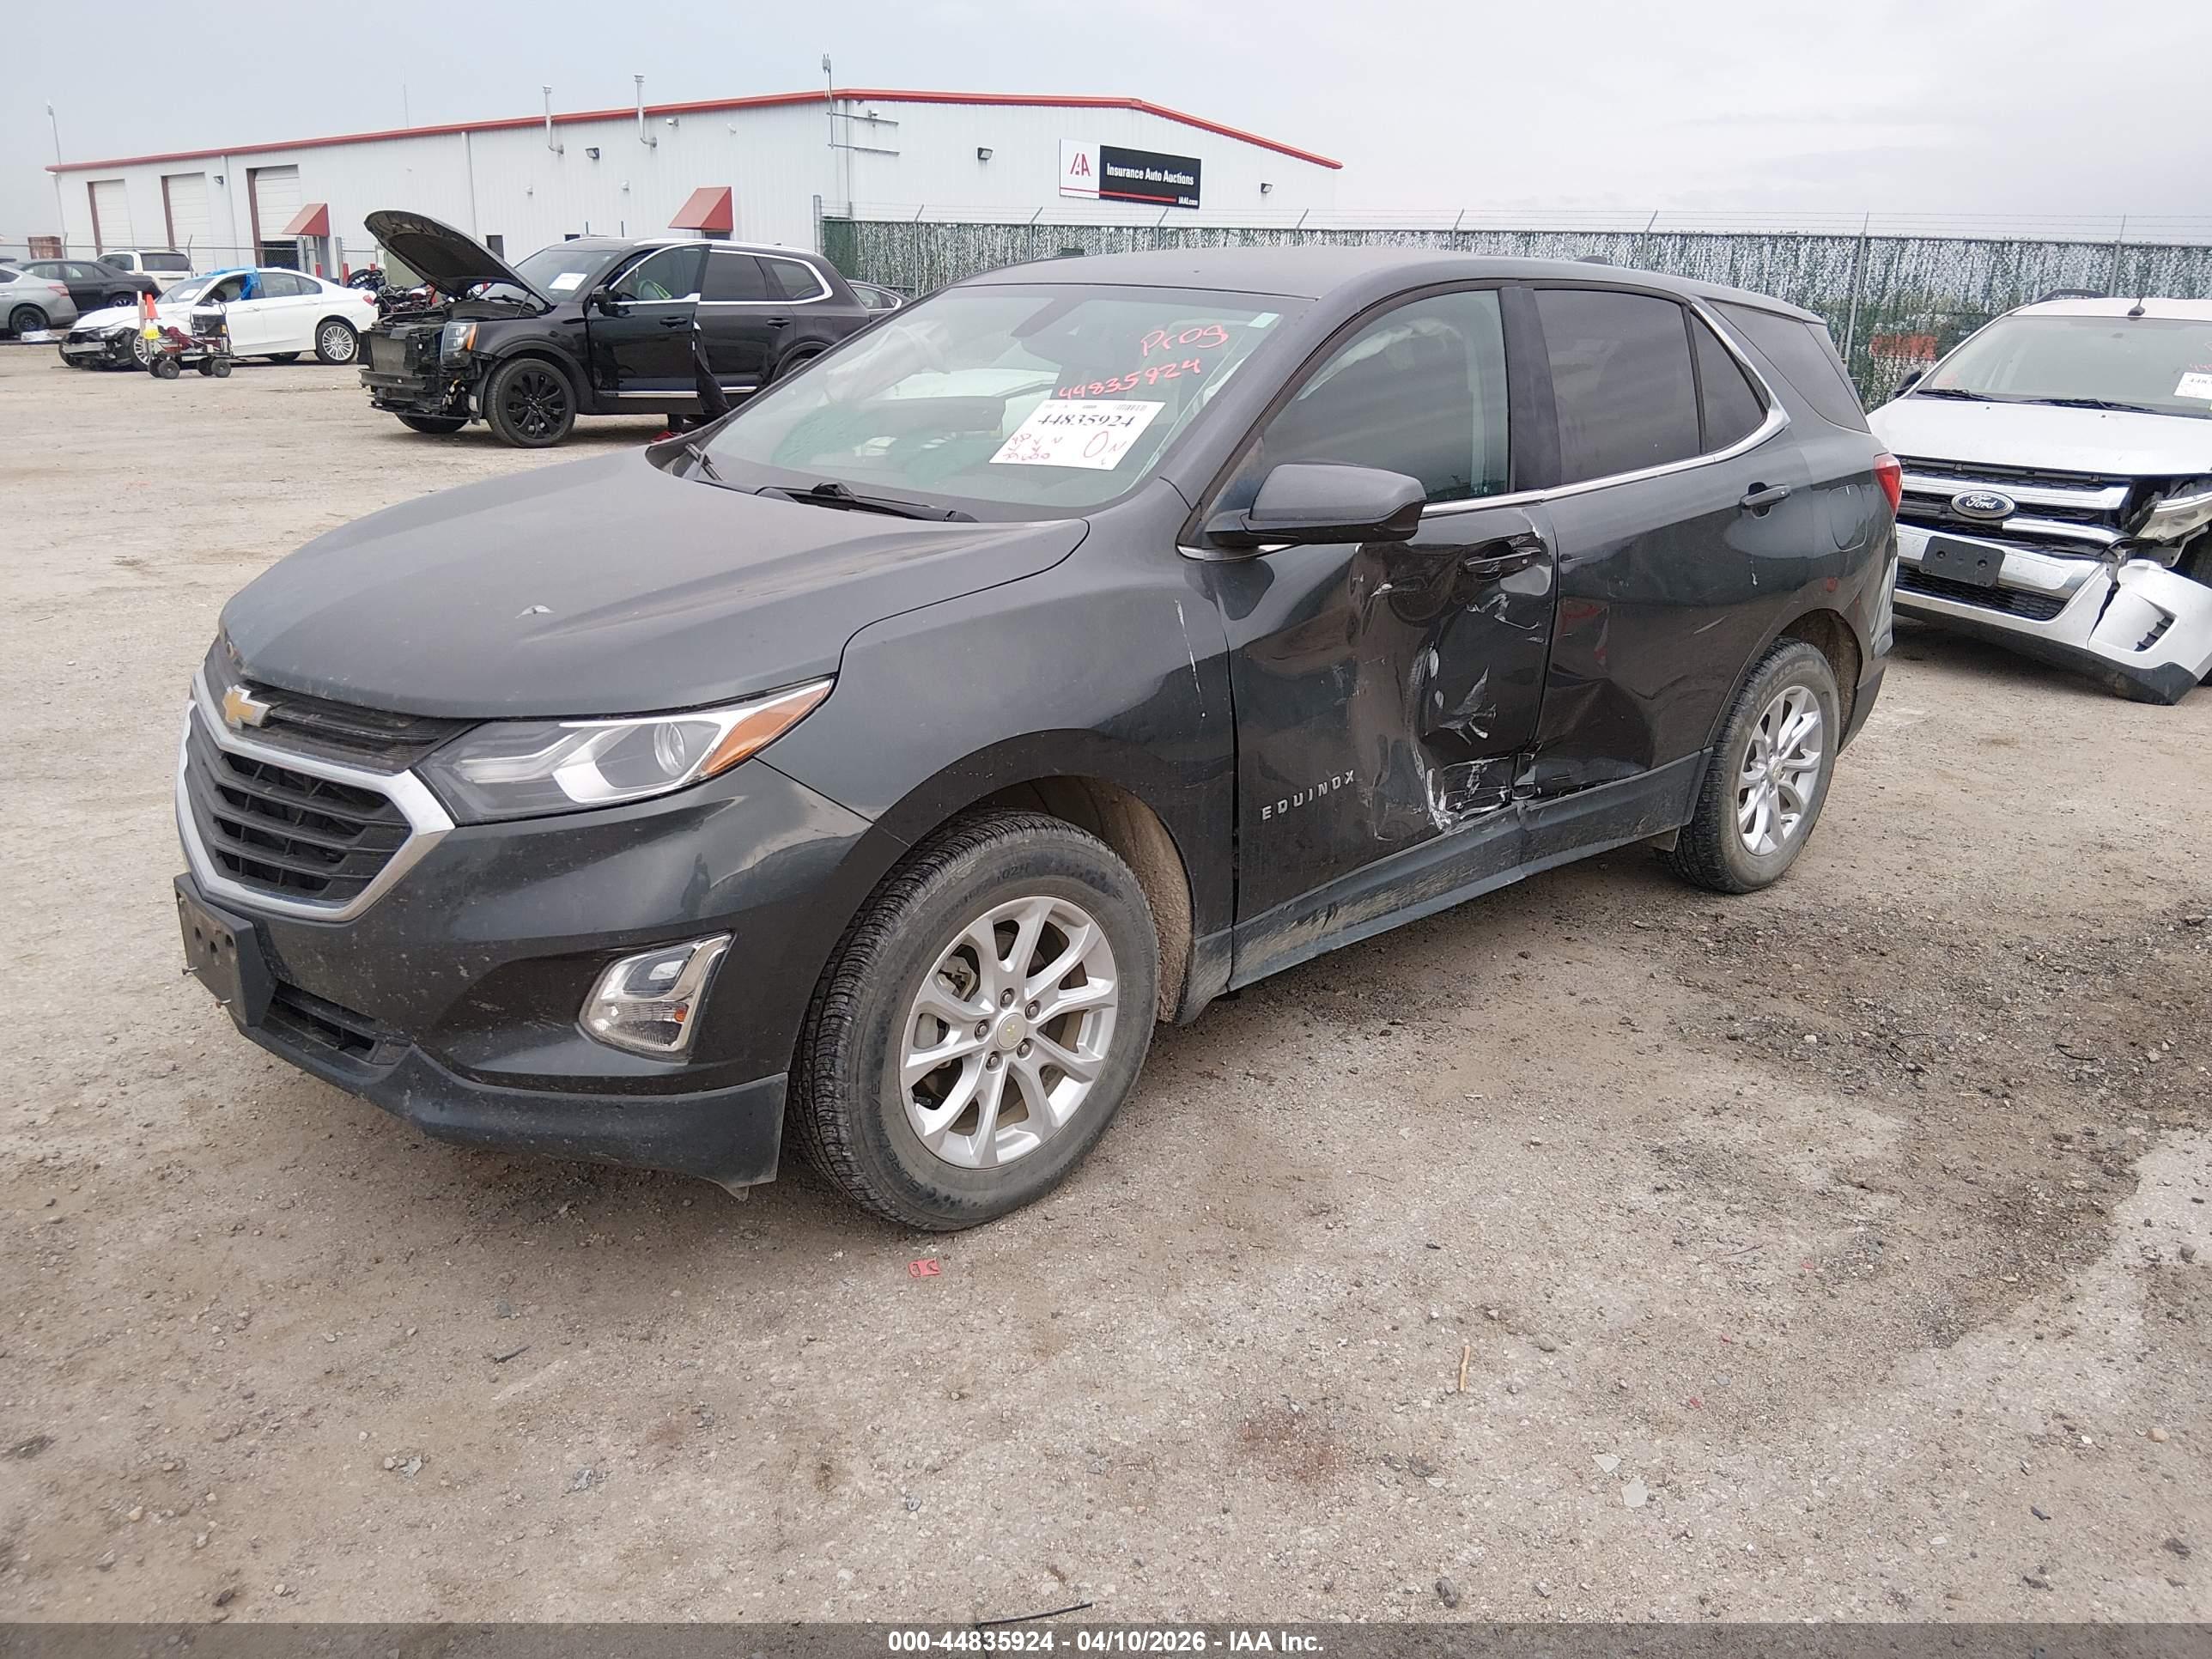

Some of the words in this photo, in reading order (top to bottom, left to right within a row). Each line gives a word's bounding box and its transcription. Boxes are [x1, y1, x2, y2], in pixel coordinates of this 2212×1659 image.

[1106, 162, 1144, 179] Insurance
[1145, 167, 1163, 182] Auto
[1163, 170, 1194, 186] Auctions
[1057, 356, 1202, 400] 44835924
[1036, 413, 1136, 428] 44835924
[1965, 495, 1998, 509] Ford
[1261, 769, 1355, 821] EQUINOX
